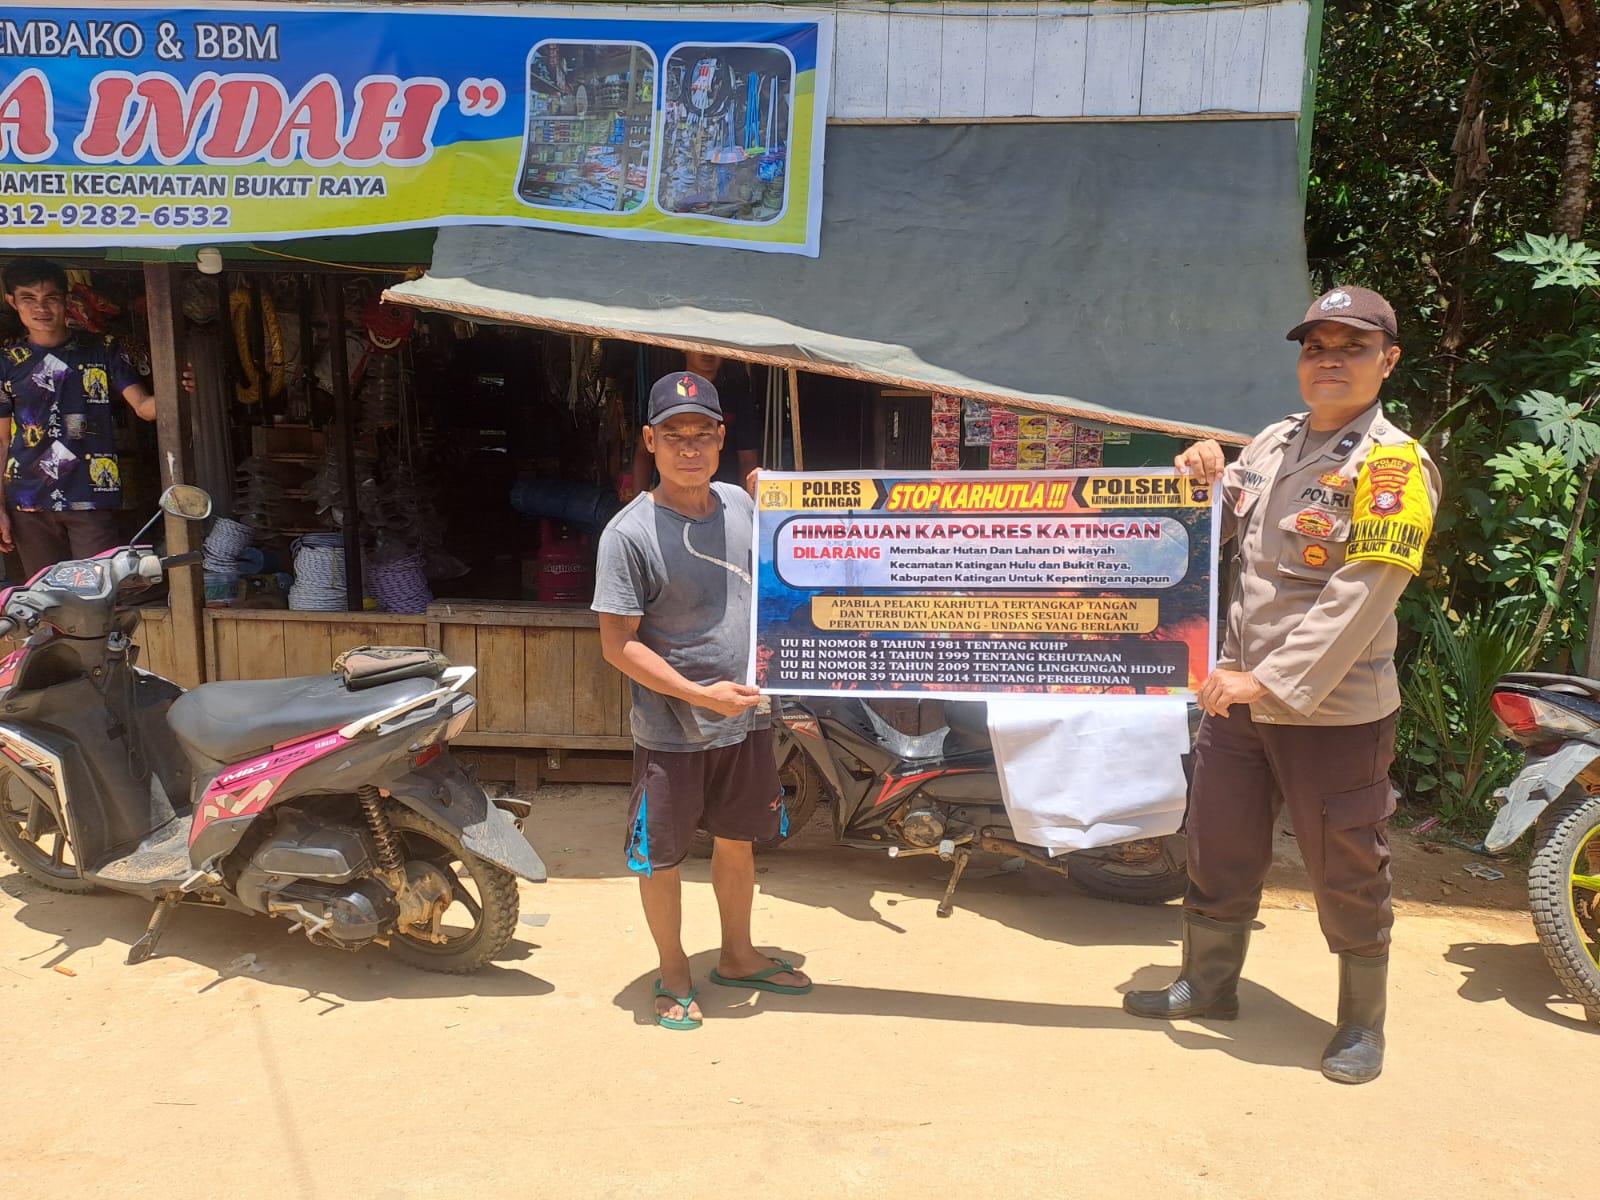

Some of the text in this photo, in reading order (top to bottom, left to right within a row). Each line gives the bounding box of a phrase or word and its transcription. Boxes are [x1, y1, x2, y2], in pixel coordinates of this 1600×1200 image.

[157, 22, 184, 60] &
[196, 24, 279, 60] BBM
[78, 76, 446, 163] INDAH
[74, 175, 226, 196] KECAMATAN
[234, 178, 313, 197] BUKIT
[319, 177, 385, 196] RAYA
[0, 205, 229, 226] 812-9282-6532
[802, 482, 861, 496] POLRES
[1092, 478, 1180, 494] POLSEK
[802, 497, 861, 507] KATINGAN
[887, 483, 941, 510] STOP
[1136, 495, 1148, 504] DAN
[1149, 495, 1166, 504] BUKIT
[1300, 488, 1349, 507] POLRI
[792, 523, 1161, 539] HIMBAUAN KAPOLRES KATINGAN
[793, 546, 1115, 559] DILARANG Membakar Hutan Dan Lahan Di wilayah
[1389, 544, 1411, 559] RAYA
[890, 561, 953, 569] Kecamatan
[955, 561, 1007, 571] Katingan
[1009, 561, 1036, 569] Hulu
[1038, 561, 1061, 569] dan
[1063, 561, 1095, 570] Bukit
[890, 574, 1170, 585] Kabupaten Katingan Untuk Kepentingan apapun
[831, 600, 1137, 610] APABILA PELAKU KARHUTLA TERTANGKAP TANGAN
[840, 610, 863, 618] DAN
[967, 610, 981, 619] DI
[983, 611, 1028, 619] PROSES
[1031, 612, 1073, 620] SESUAI
[1076, 612, 1128, 620] DENGAN
[829, 620, 900, 629] PERATURAN
[903, 621, 928, 629] DAN
[931, 621, 981, 630] UNDANG
[991, 622, 1042, 630] UNDANG
[1045, 622, 1078, 631] YANG
[1081, 623, 1139, 631] BERLAKU
[781, 639, 798, 647] UU
[818, 639, 867, 648] NOMOR
[870, 640, 878, 648] 8
[881, 640, 926, 649] TAHUN
[930, 641, 961, 649] 1981
[964, 641, 1027, 650] TENTANG
[1030, 641, 1068, 650] KUHP
[781, 650, 1122, 662] UU RI NOMOR 41 TAHUN 1999 TENTANG KEHUTANAN
[780, 661, 1176, 674] UU RI NOMOR 32 TAHUN 2009 TENTANG LINGKUNGAN HIDUP
[780, 671, 1130, 685] UU RI NOMOR 39 TAHUN 2014 TENTANG PERKEBUNAN
